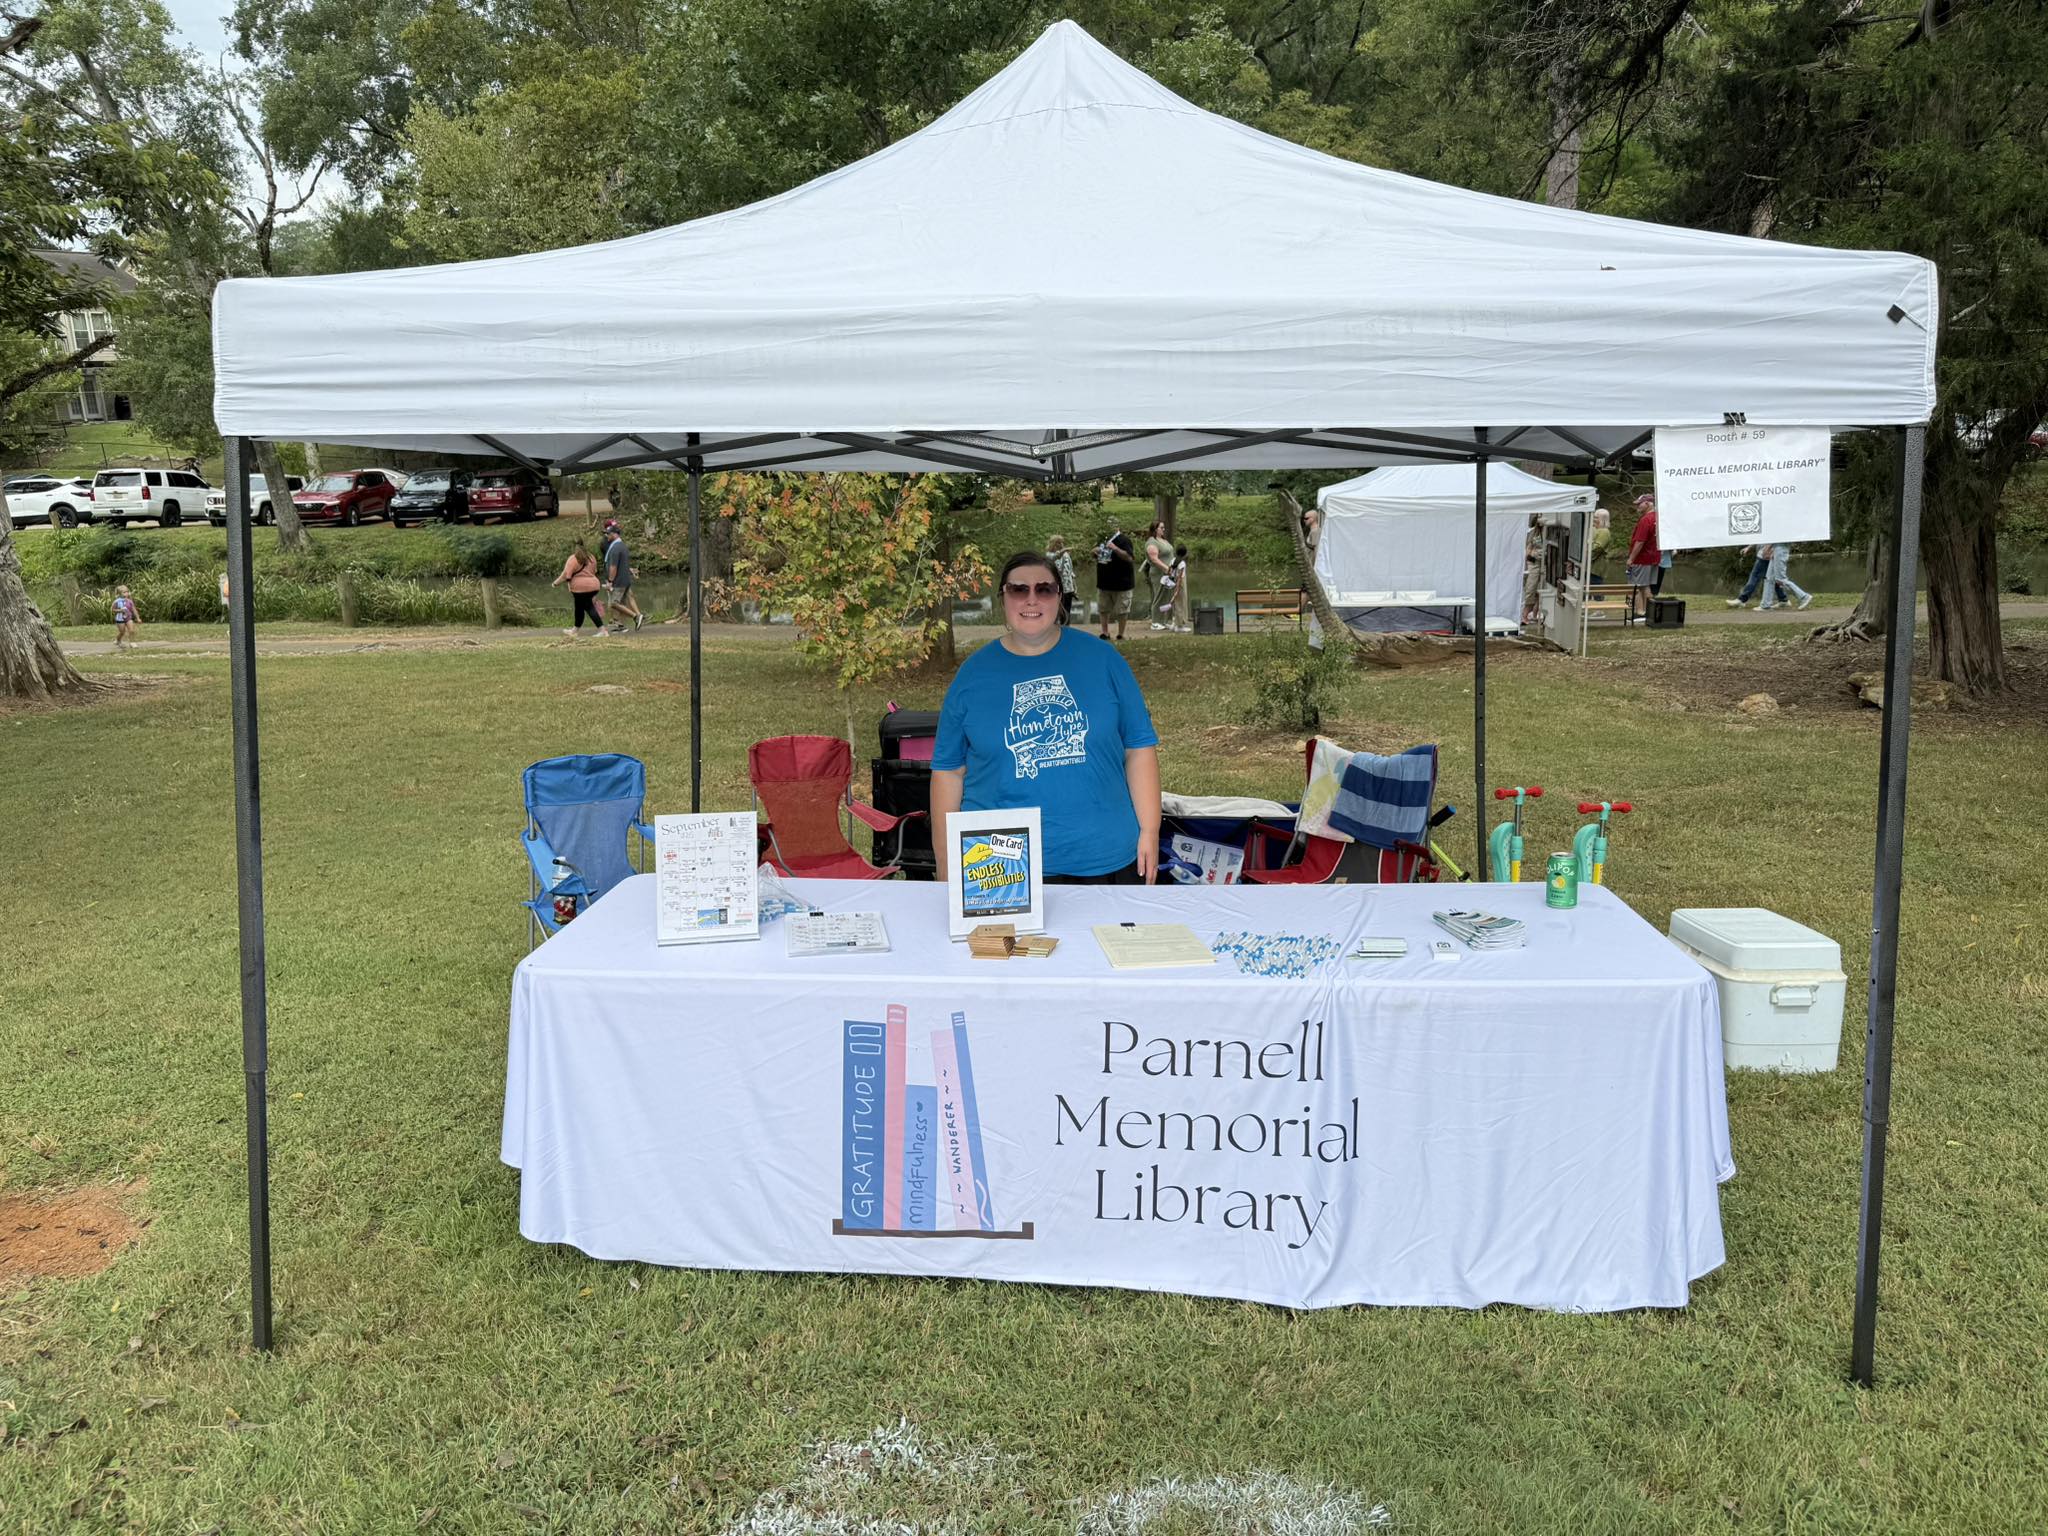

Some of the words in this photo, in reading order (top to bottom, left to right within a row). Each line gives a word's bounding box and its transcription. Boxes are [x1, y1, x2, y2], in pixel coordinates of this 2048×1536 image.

[1706, 431, 1738, 443] Booth
[1740, 431, 1747, 440] #
[1752, 430, 1766, 440] 59
[1717, 461, 1774, 474] MEMORIAL
[1690, 488, 1752, 501] COMMUNITY
[1753, 485, 1796, 497] VENDOR
[1014, 695, 1073, 715] MONTEVALLO
[1008, 710, 1084, 741] Hometown
[1045, 721, 1084, 744] Hype
[661, 817, 719, 837] September
[991, 835, 1005, 847] One
[1005, 838, 1023, 850] Card
[967, 862, 1005, 882] ENDLESS
[979, 871, 1026, 892] POSSIBILITIES
[1101, 1019, 1324, 1082] Parnell
[944, 1101, 962, 1174] WANDERER
[1054, 1094, 1360, 1163] Memorial
[851, 1064, 876, 1218] GRATITUDE
[1094, 1164, 1329, 1250] Library
